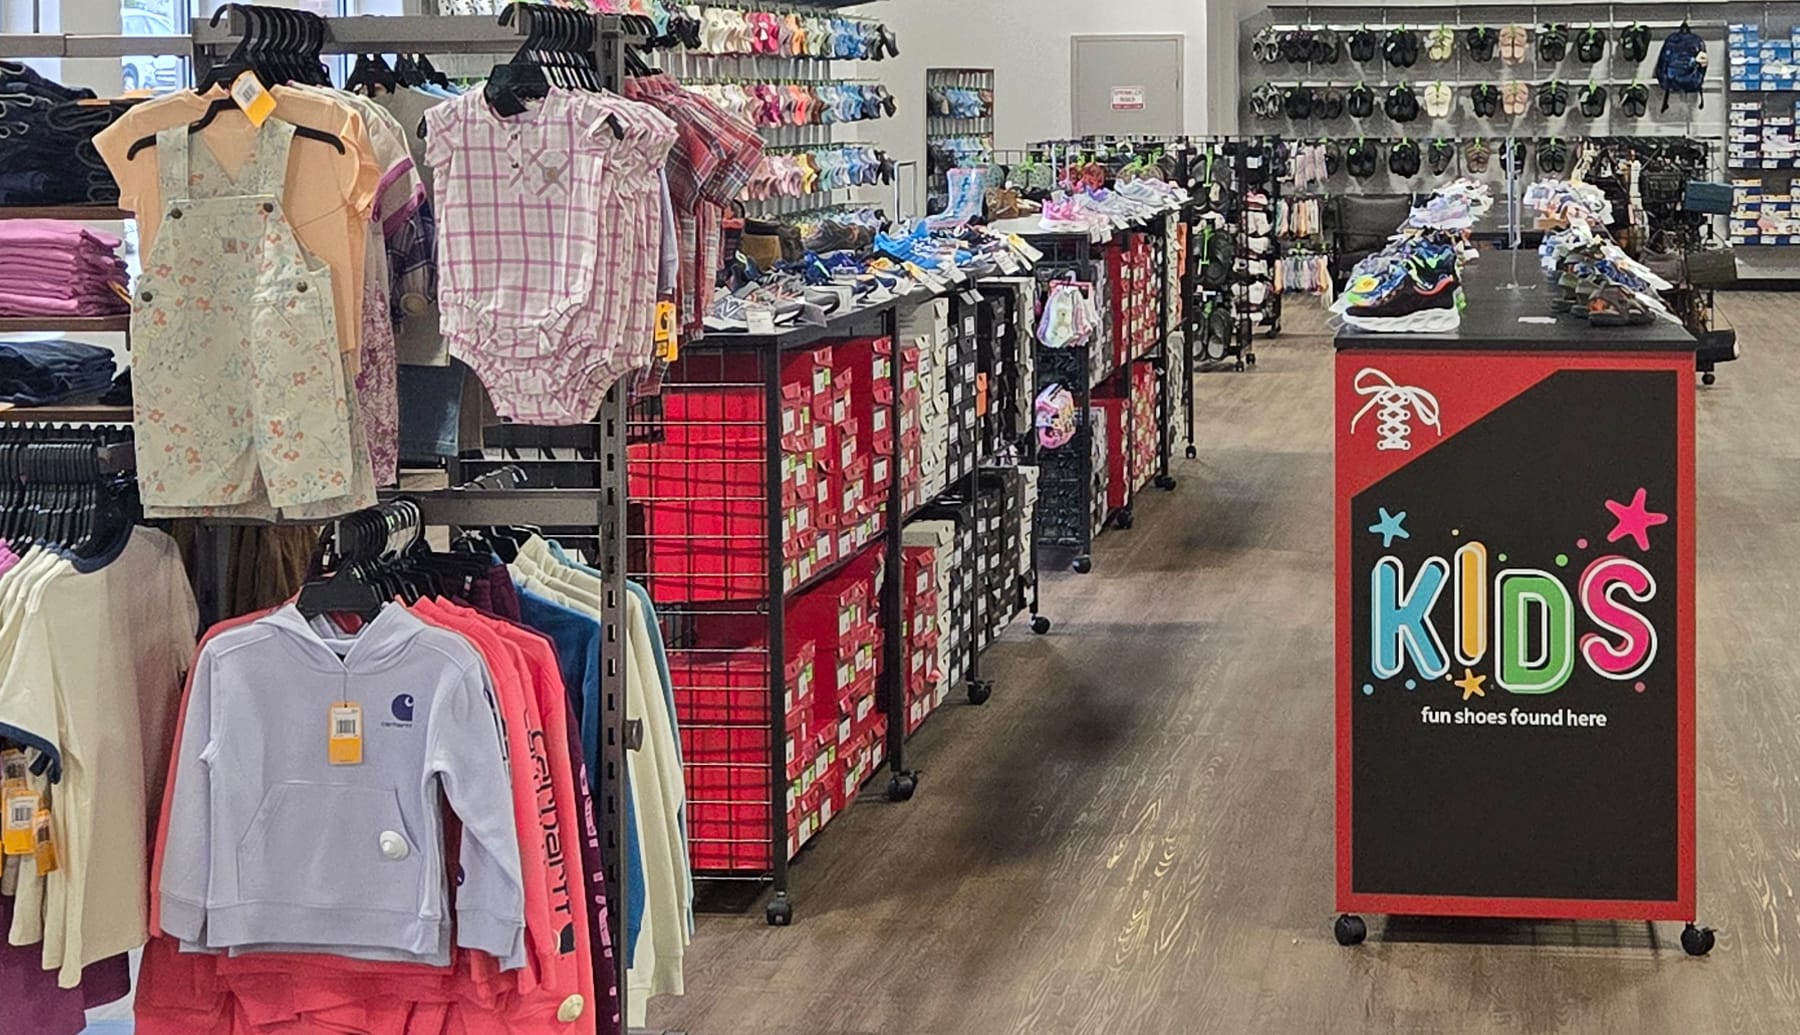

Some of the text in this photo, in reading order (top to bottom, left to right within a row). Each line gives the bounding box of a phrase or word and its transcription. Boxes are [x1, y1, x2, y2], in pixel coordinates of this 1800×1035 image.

[1371, 541, 1658, 695] KIDS
[1421, 706, 1607, 727] fun shoes found here
